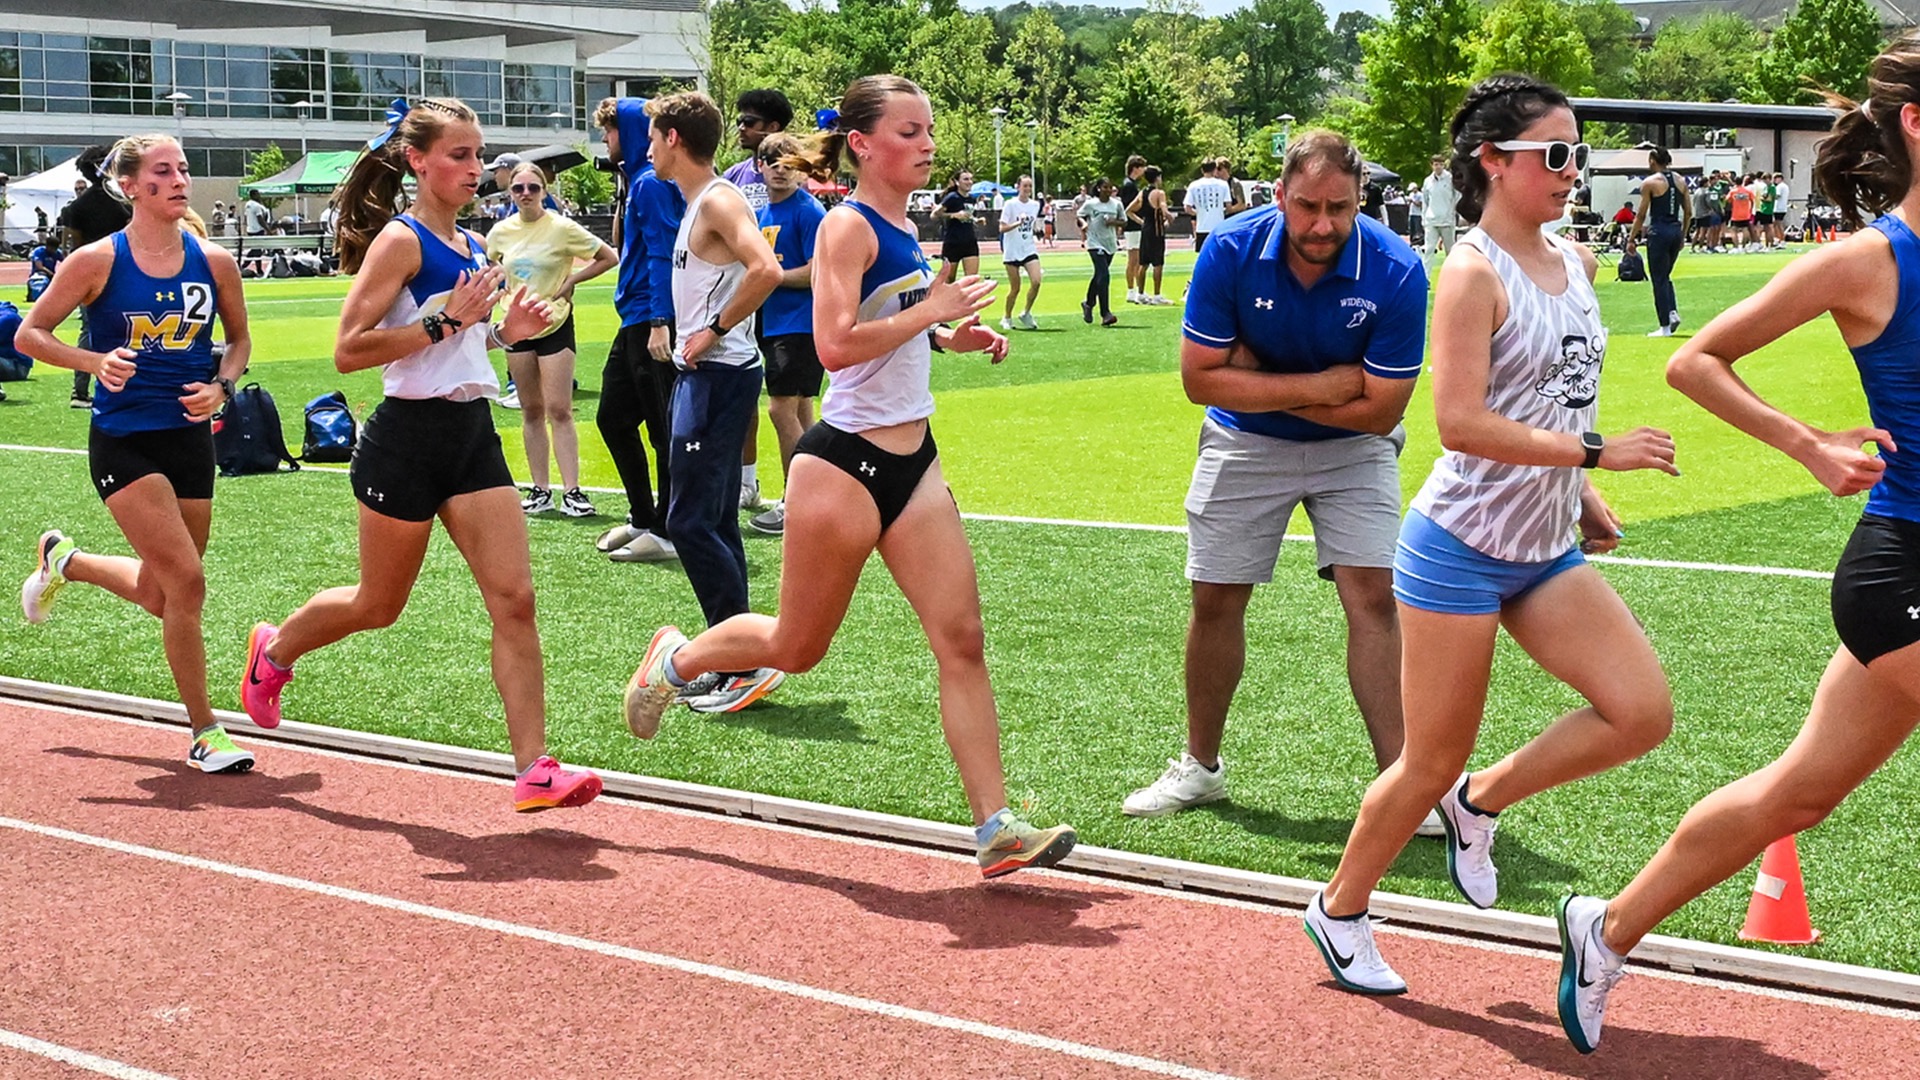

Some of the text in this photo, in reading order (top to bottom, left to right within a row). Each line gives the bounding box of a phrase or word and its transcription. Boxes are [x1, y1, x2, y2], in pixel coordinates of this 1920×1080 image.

[186, 284, 207, 321] 2
[1340, 297, 1378, 315] WIDENER
[122, 310, 204, 353] MU
